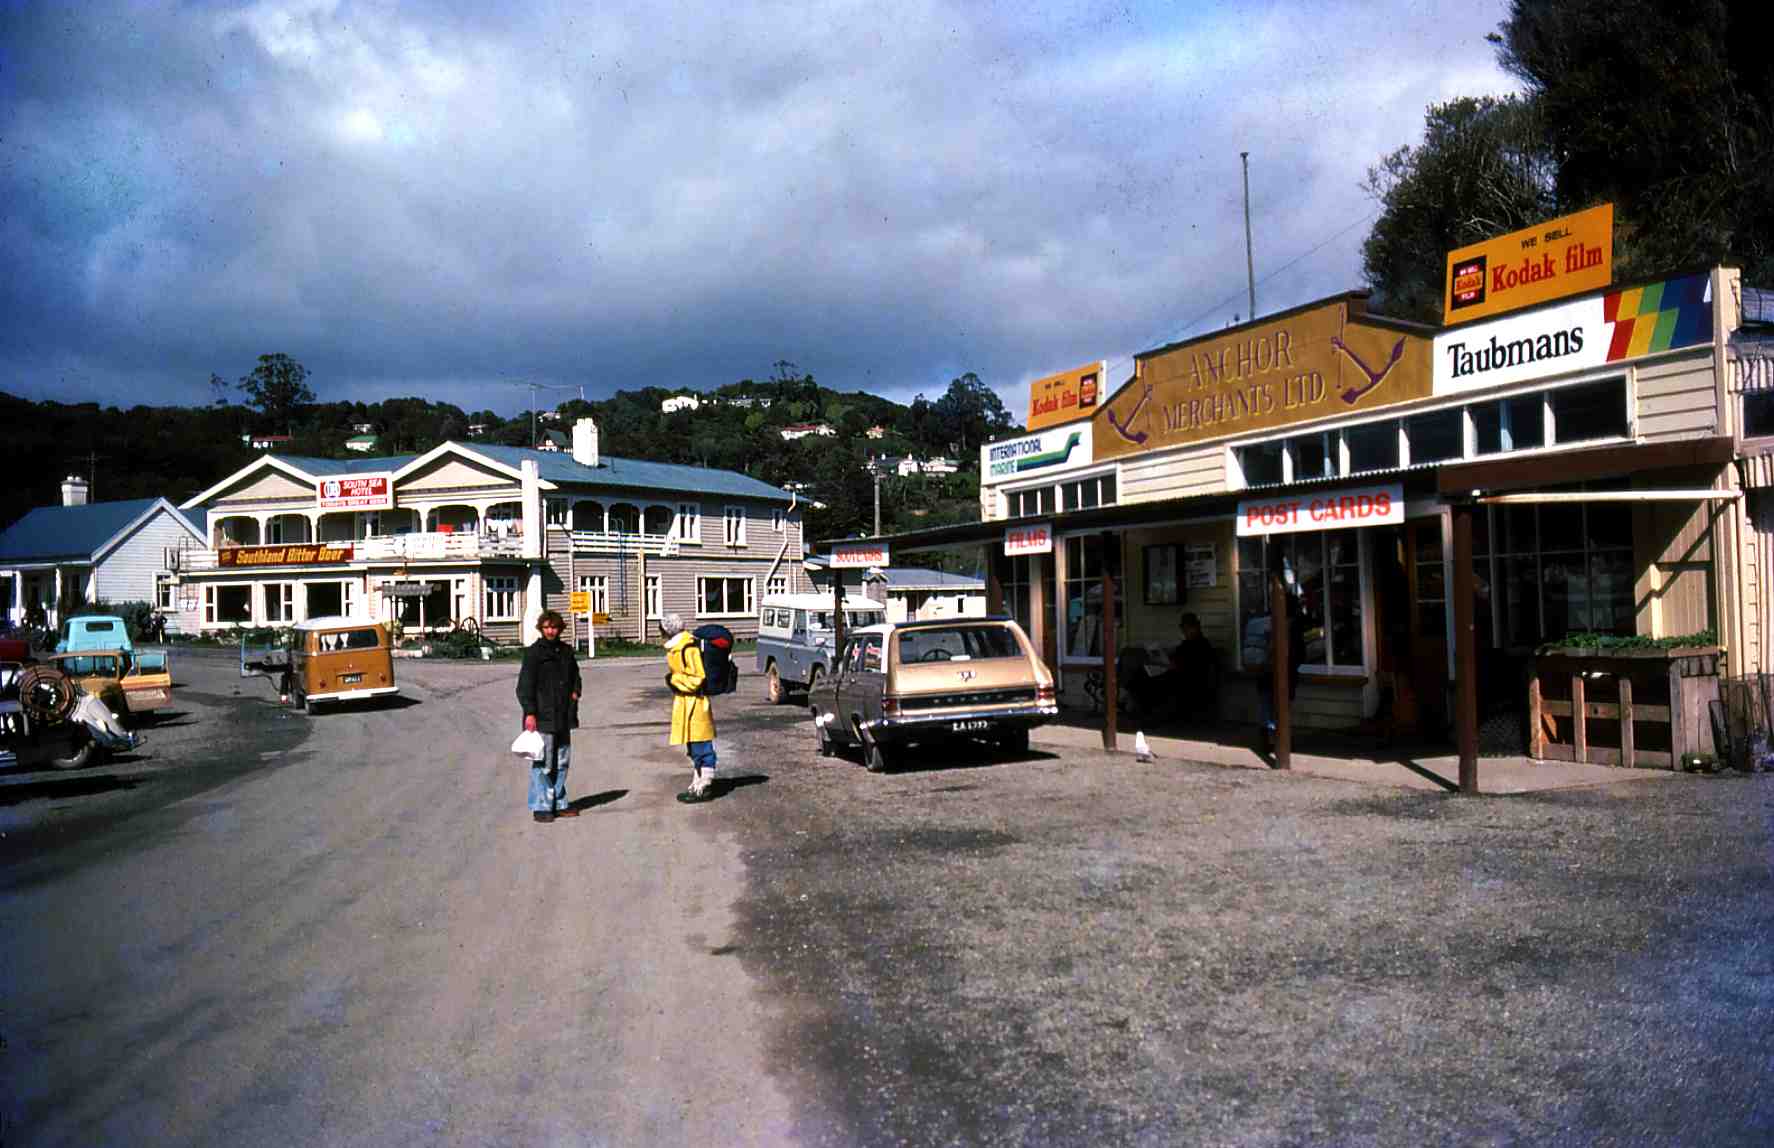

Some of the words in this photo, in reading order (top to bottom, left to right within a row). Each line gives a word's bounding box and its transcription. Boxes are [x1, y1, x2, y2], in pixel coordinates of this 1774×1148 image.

[1521, 237, 1537, 249] WE
[1544, 227, 1572, 242] SELL
[1490, 253, 1557, 293] Kodak
[1565, 243, 1603, 274] film
[1188, 330, 1294, 392] ANCHOR
[1447, 327, 1584, 378] Taubmans
[1162, 384, 1275, 434] MERCHANTS
[989, 437, 1042, 461] INTERNATIONAL
[343, 479, 368, 489] SOUTH
[368, 478, 383, 488] SEA
[351, 487, 373, 496] HOTEL
[1247, 501, 1300, 527] POST
[1310, 490, 1391, 522] CARDS
[1008, 529, 1047, 548] FILMS
[236, 548, 285, 564] Southland
